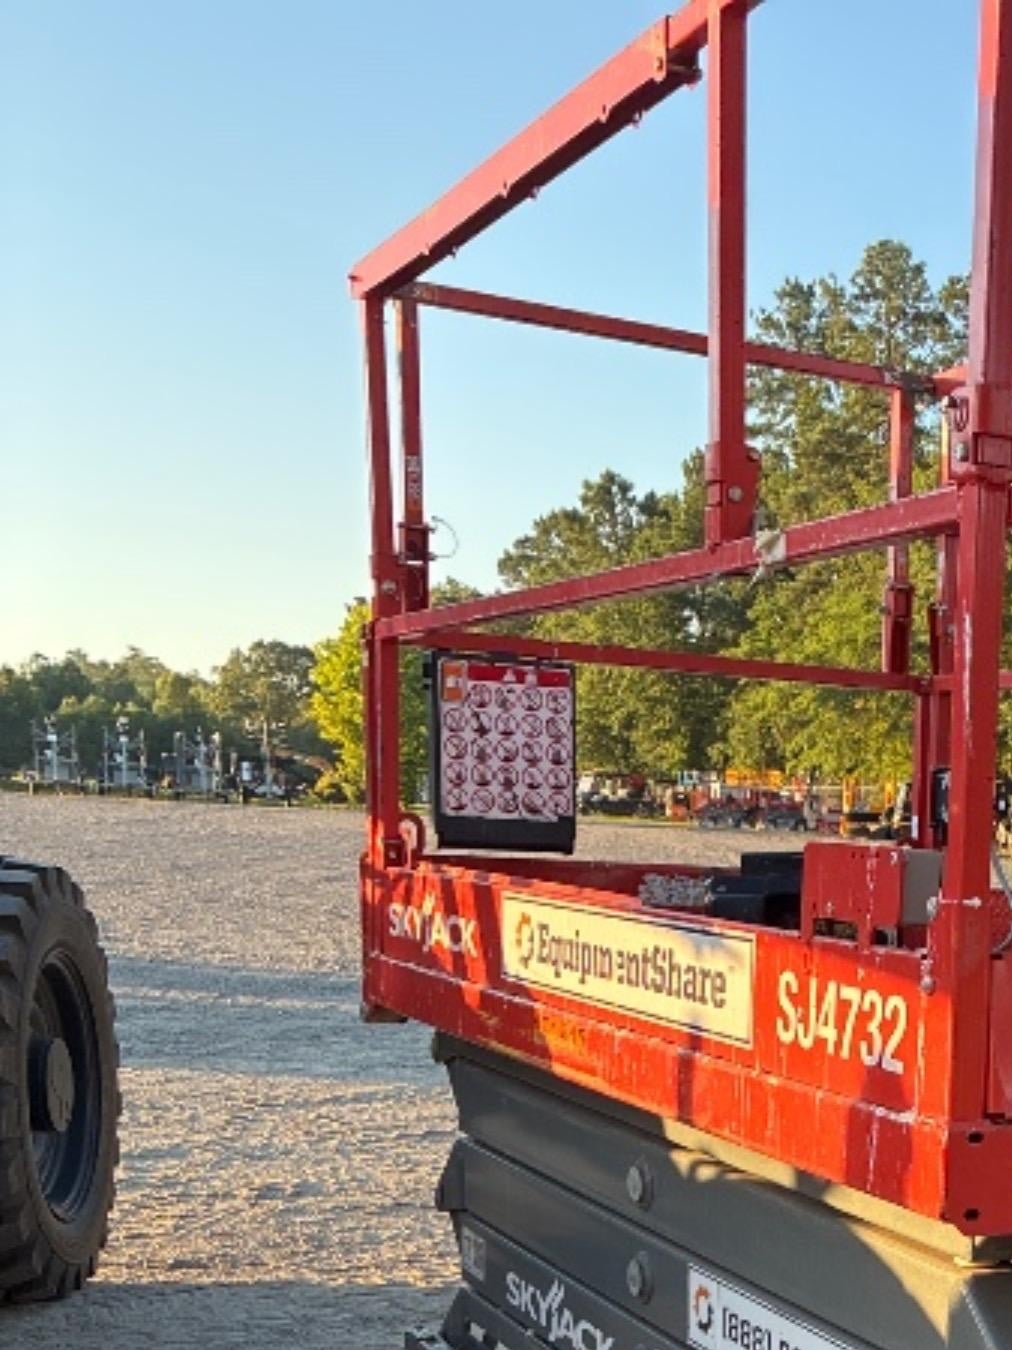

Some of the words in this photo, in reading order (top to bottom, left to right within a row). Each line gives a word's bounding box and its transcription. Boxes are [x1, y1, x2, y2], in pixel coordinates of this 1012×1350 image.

[389, 892, 478, 957] SKYJACK
[536, 922, 727, 1008] EquipmentShare
[776, 969, 907, 1075] SJ4732
